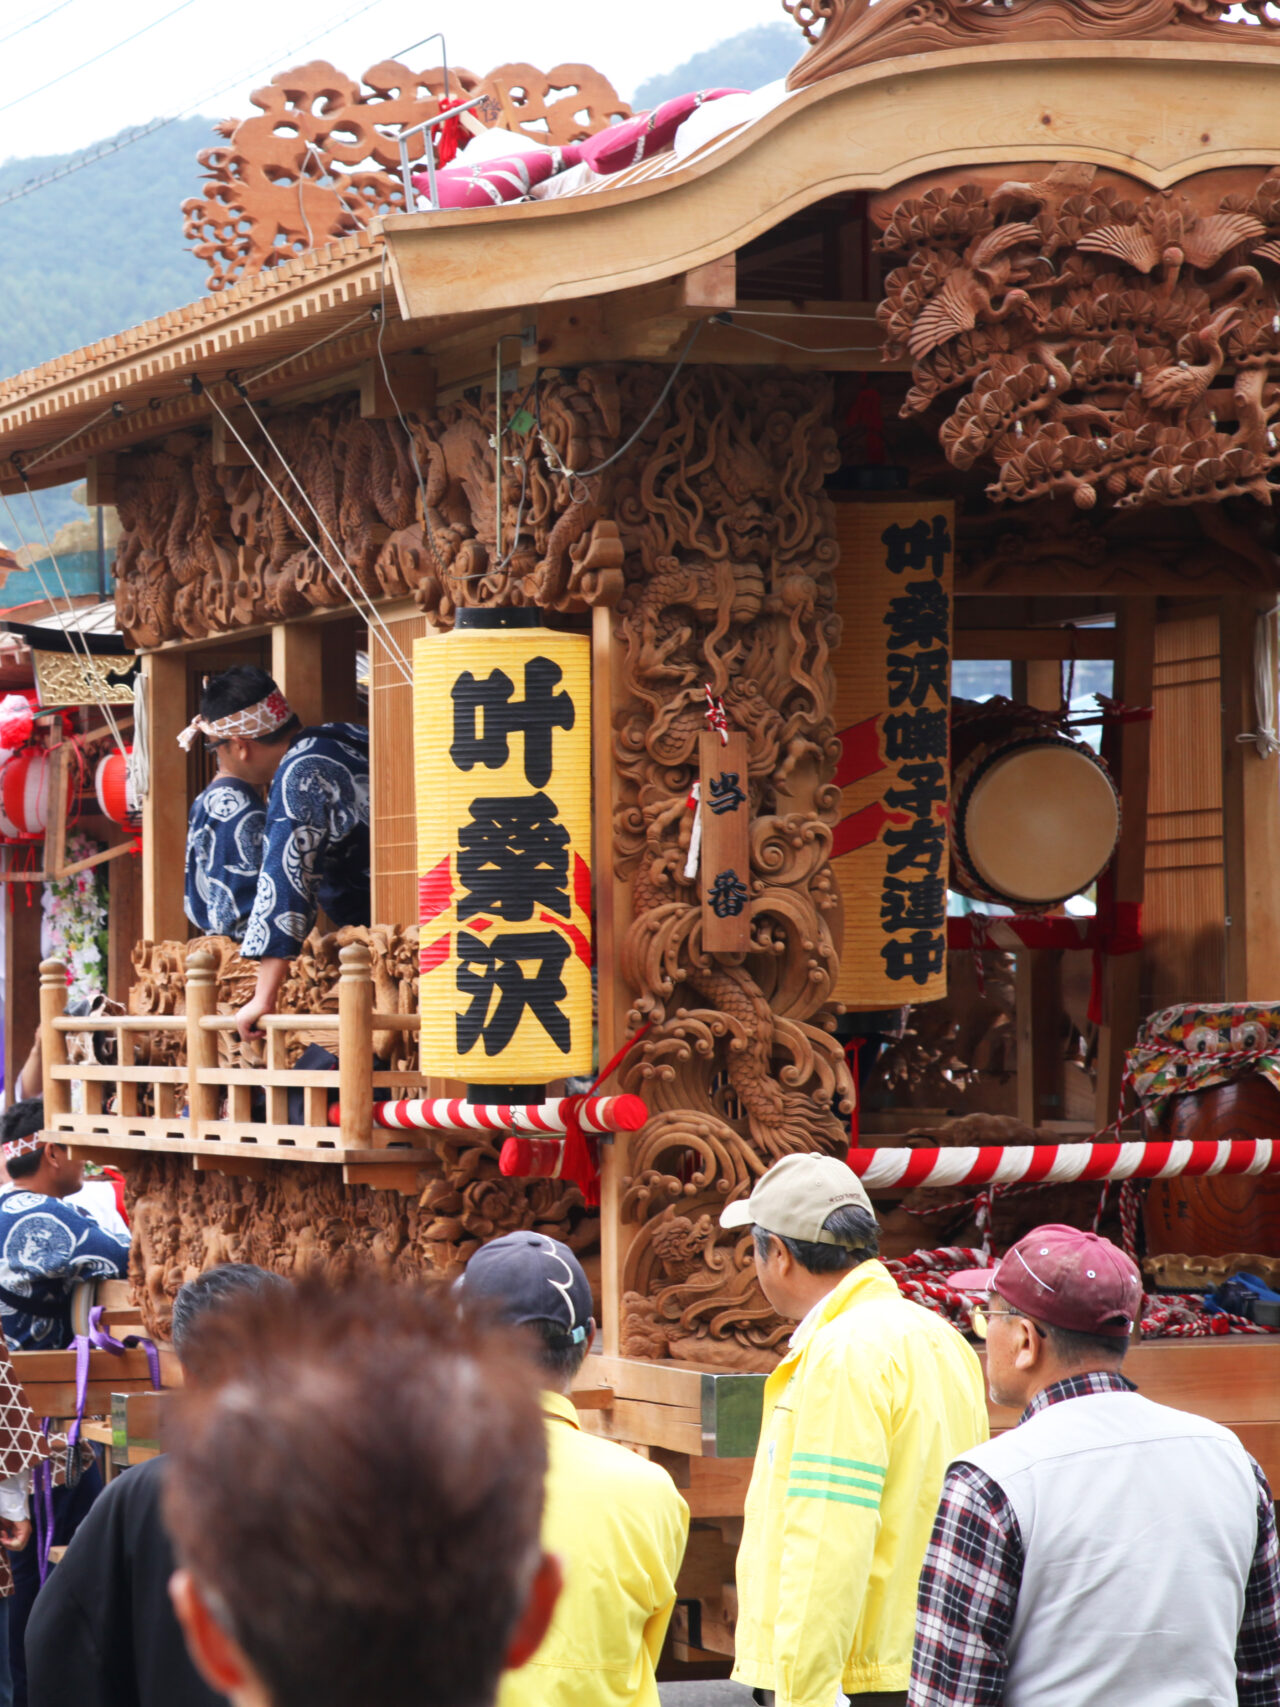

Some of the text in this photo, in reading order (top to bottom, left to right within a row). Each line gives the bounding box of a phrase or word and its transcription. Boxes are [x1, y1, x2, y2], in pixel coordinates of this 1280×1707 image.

[448, 655, 576, 1057] 叶桑沢
[706, 771, 748, 919] 当番
